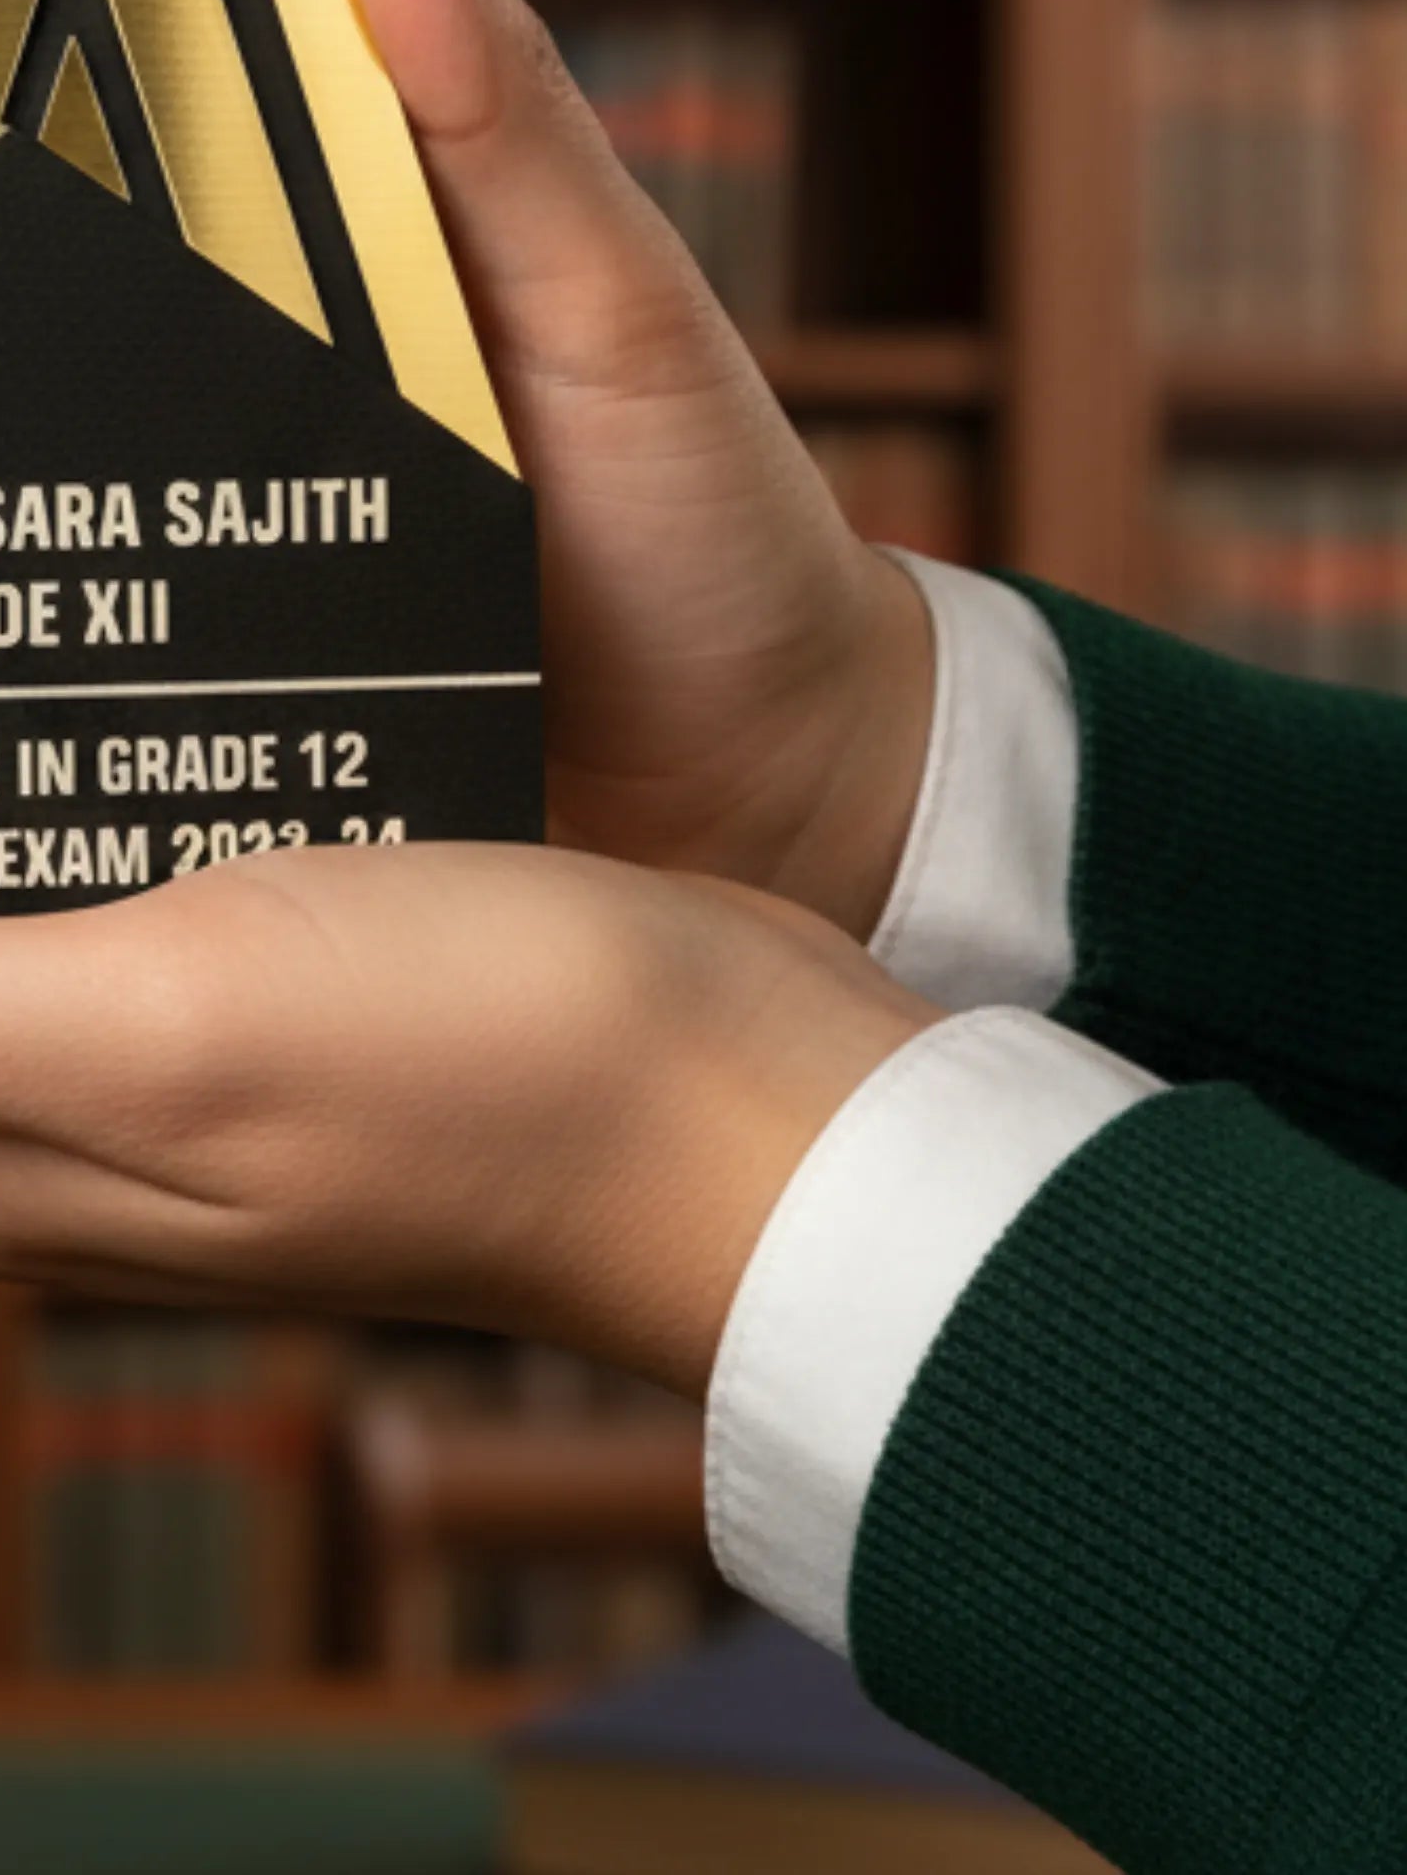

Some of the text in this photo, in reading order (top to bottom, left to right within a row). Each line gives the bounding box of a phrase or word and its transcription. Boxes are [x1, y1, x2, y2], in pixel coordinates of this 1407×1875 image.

[165, 478, 388, 547] SAJITH
[83, 580, 169, 645] XII
[19, 740, 76, 796] IN
[98, 734, 279, 795] GRADE
[299, 732, 369, 789] 12
